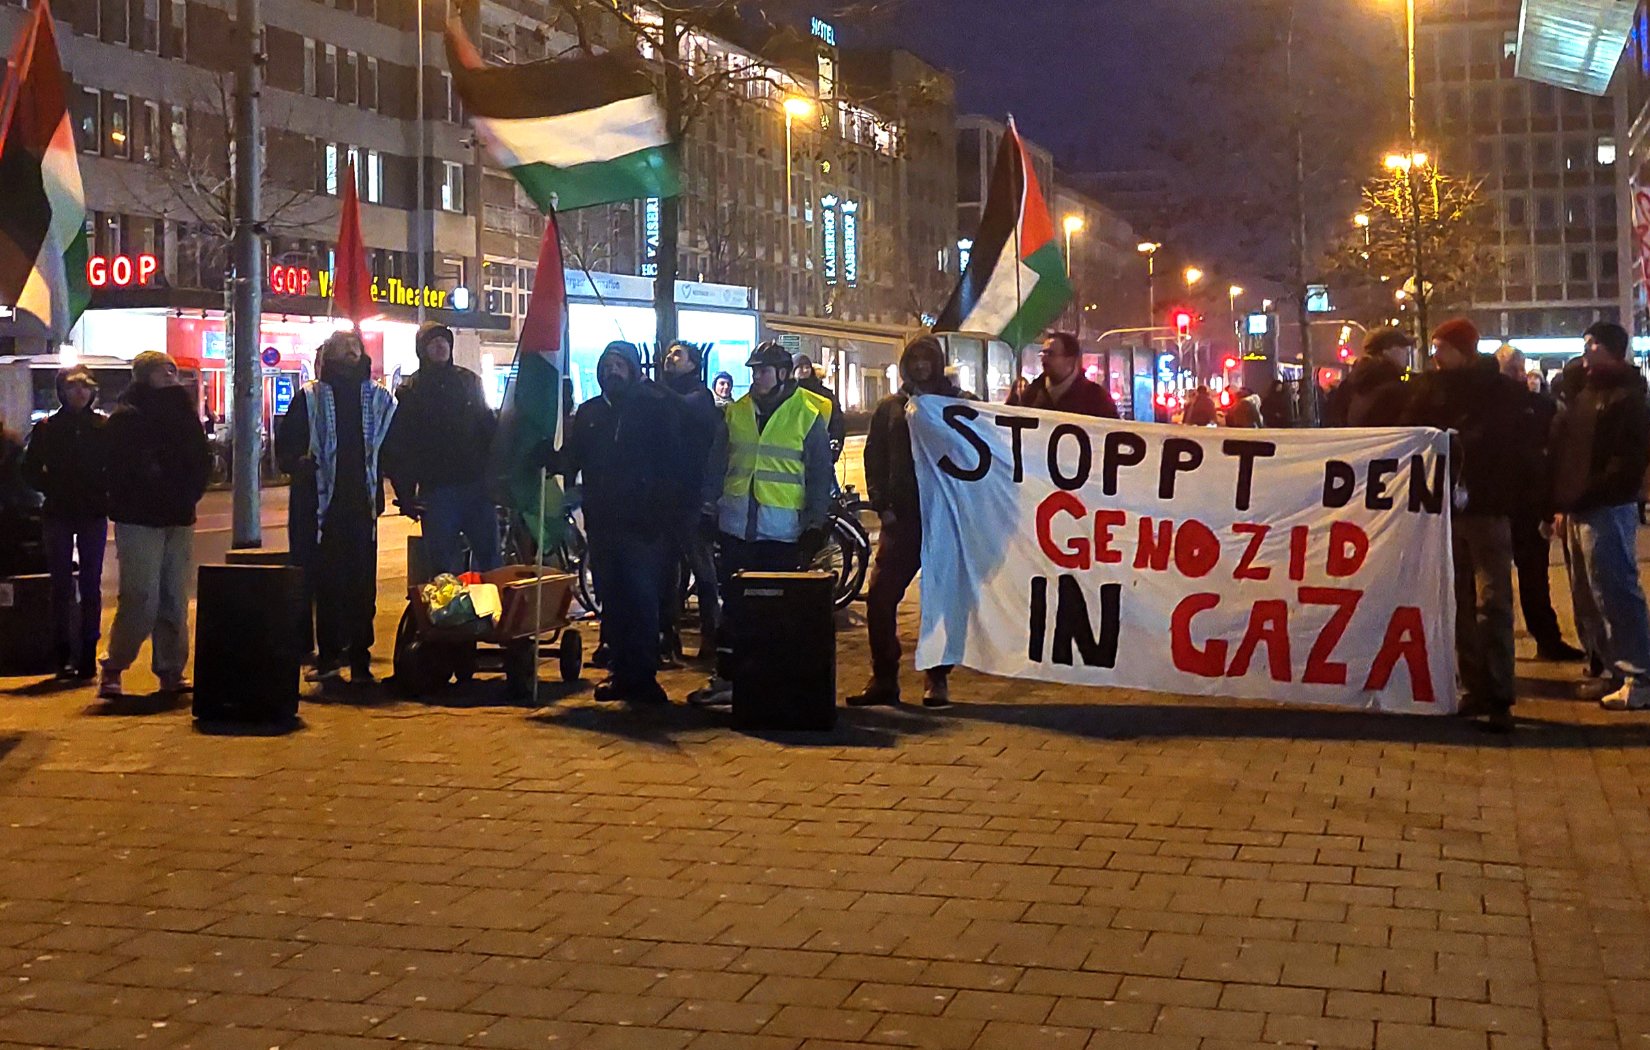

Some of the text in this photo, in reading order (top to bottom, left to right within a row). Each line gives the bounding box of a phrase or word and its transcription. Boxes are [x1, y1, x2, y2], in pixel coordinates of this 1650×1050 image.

[87, 253, 158, 288] GOP
[823, 209, 836, 278] KAISERHOF
[843, 214, 856, 281] KAISERHOF
[271, 265, 312, 295] GOP
[937, 404, 1447, 515] STOPPT DEN
[1035, 489, 1370, 578] GENOZID
[1027, 573, 1435, 703] IN GAZA
